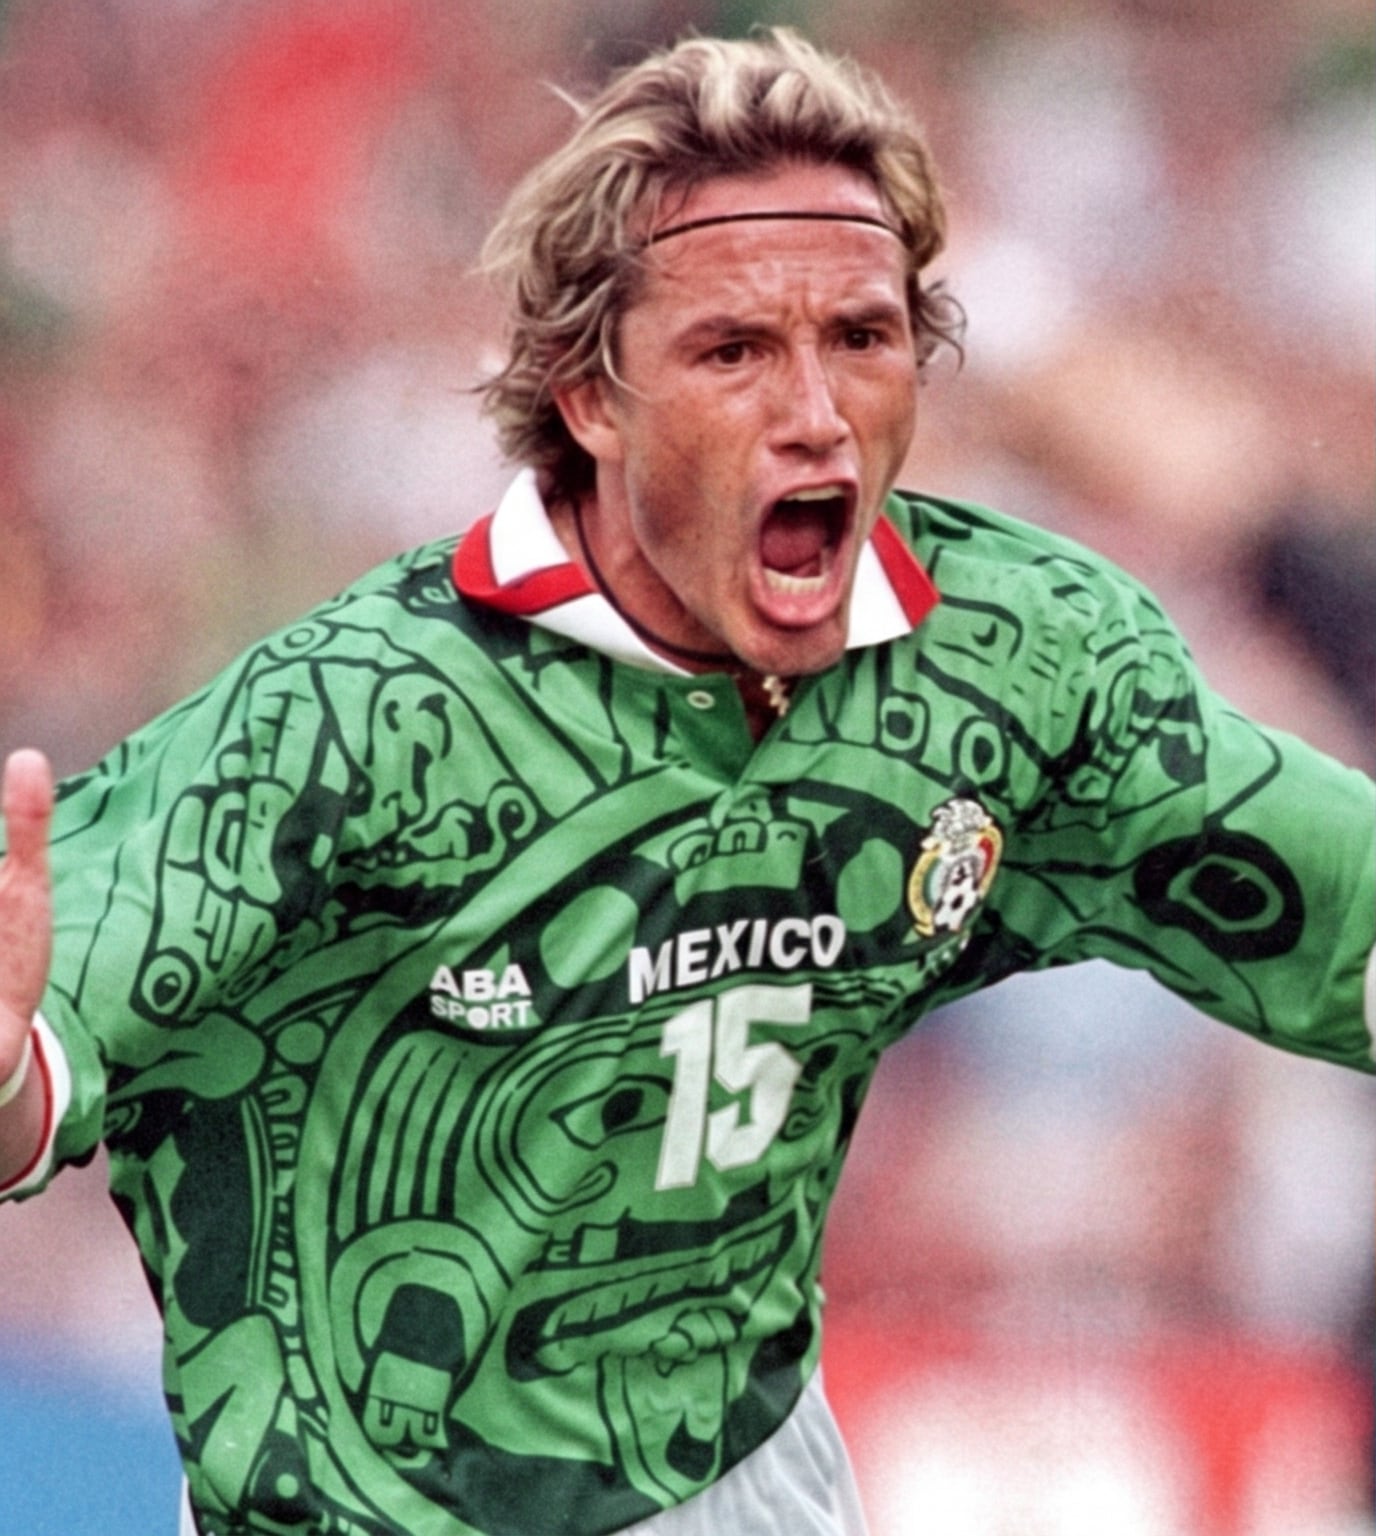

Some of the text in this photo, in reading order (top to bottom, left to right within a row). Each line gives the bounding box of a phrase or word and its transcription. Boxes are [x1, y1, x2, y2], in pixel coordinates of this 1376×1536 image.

[429, 963, 532, 1002] ABA
[629, 914, 845, 1003] MEXICO
[430, 994, 532, 1030] SPORT
[654, 983, 813, 1191] 15
